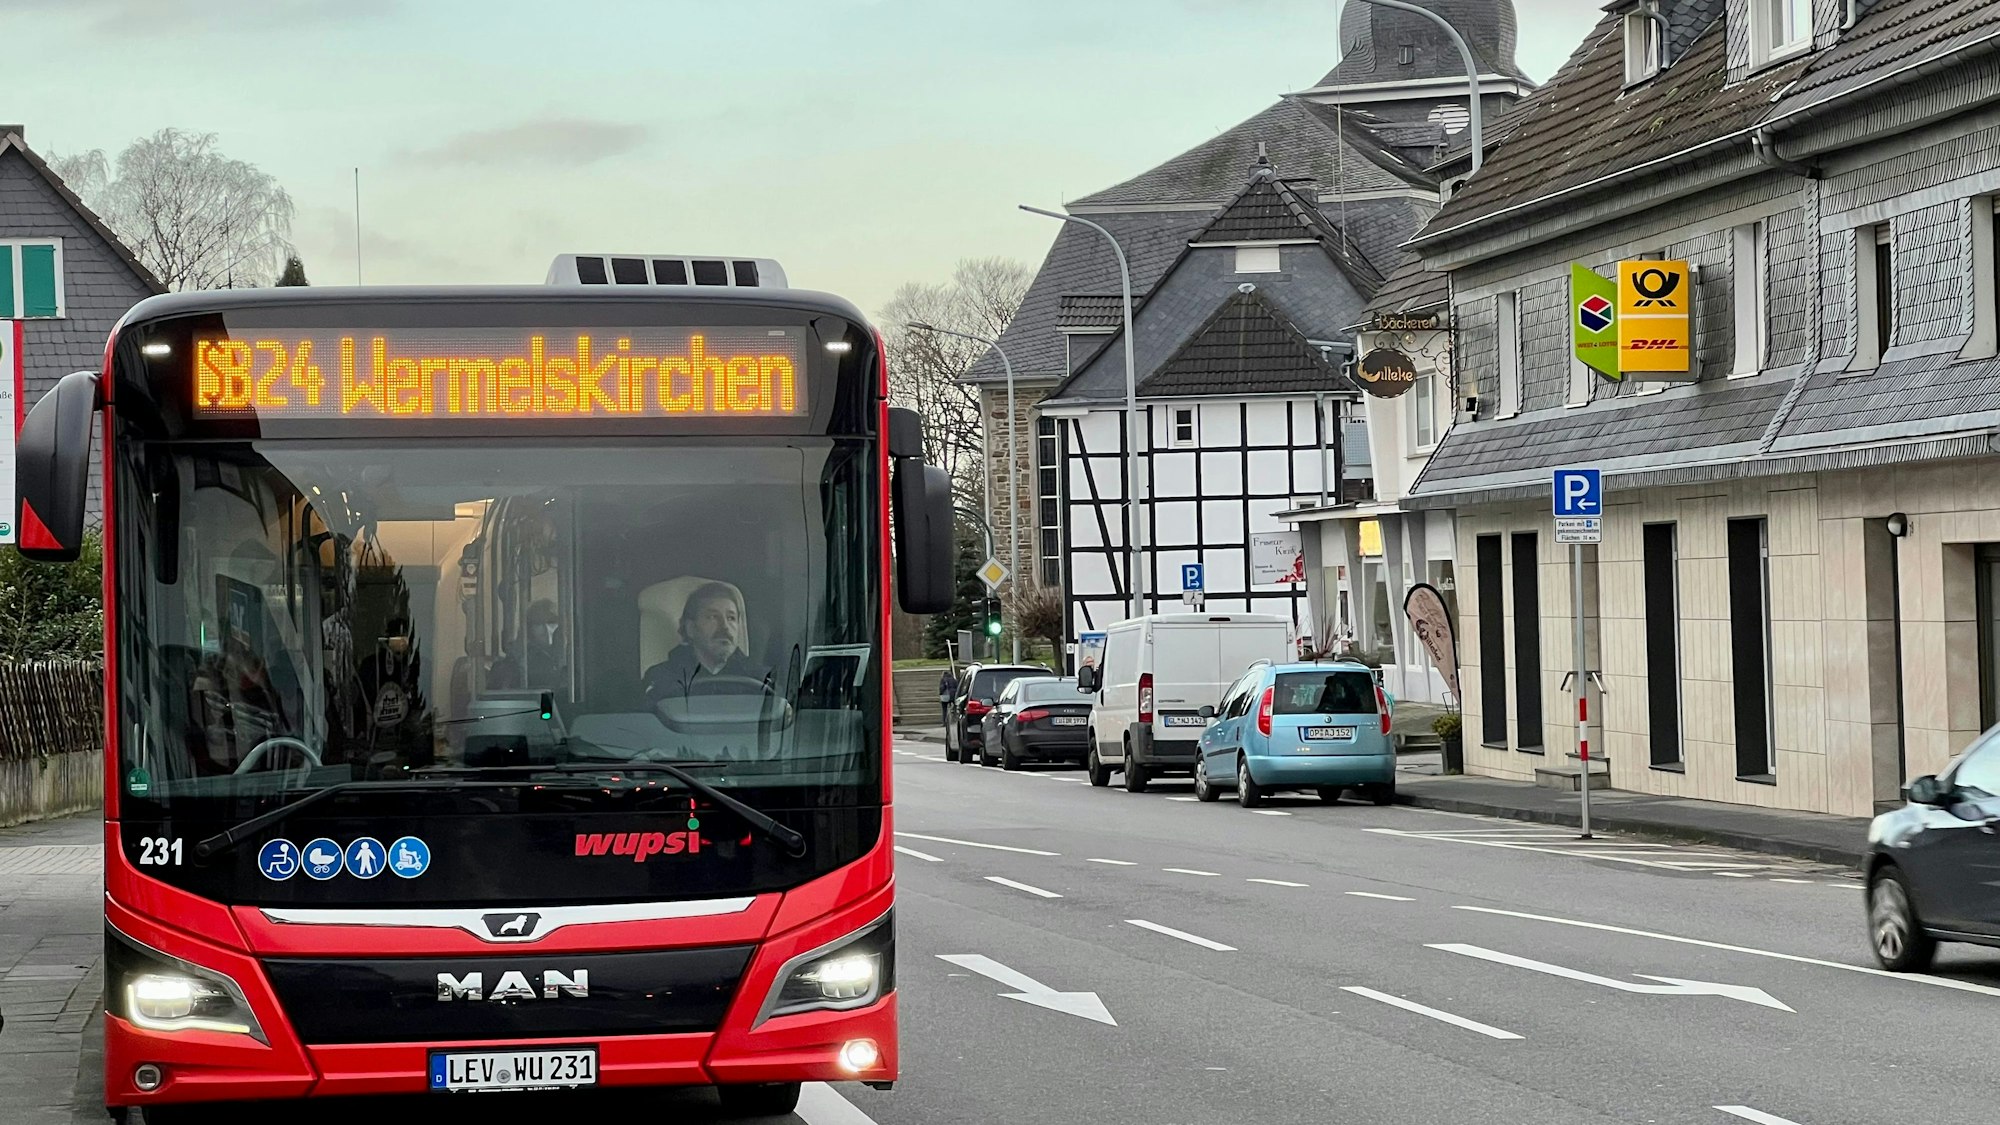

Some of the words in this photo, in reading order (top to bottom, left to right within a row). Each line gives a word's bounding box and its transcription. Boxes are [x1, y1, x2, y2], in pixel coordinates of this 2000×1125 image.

[1379, 313, 1433, 329] Bäckerei
[1630, 339, 1679, 350] DHL
[197, 340, 326, 407] SB24
[341, 334, 795, 413] Wermelskirchen
[1564, 475, 1590, 510] P
[1186, 567, 1198, 587] P
[1309, 728, 1319, 737] OP
[1324, 728, 1335, 737] AJ
[1336, 728, 1350, 737] 152
[139, 836, 183, 866] 231
[575, 817, 700, 863] wupsi
[436, 969, 589, 1002] MAN
[435, 1074, 443, 1083] D
[449, 1057, 495, 1084] LEV
[513, 1056, 544, 1081] WU
[550, 1055, 593, 1080] 231
